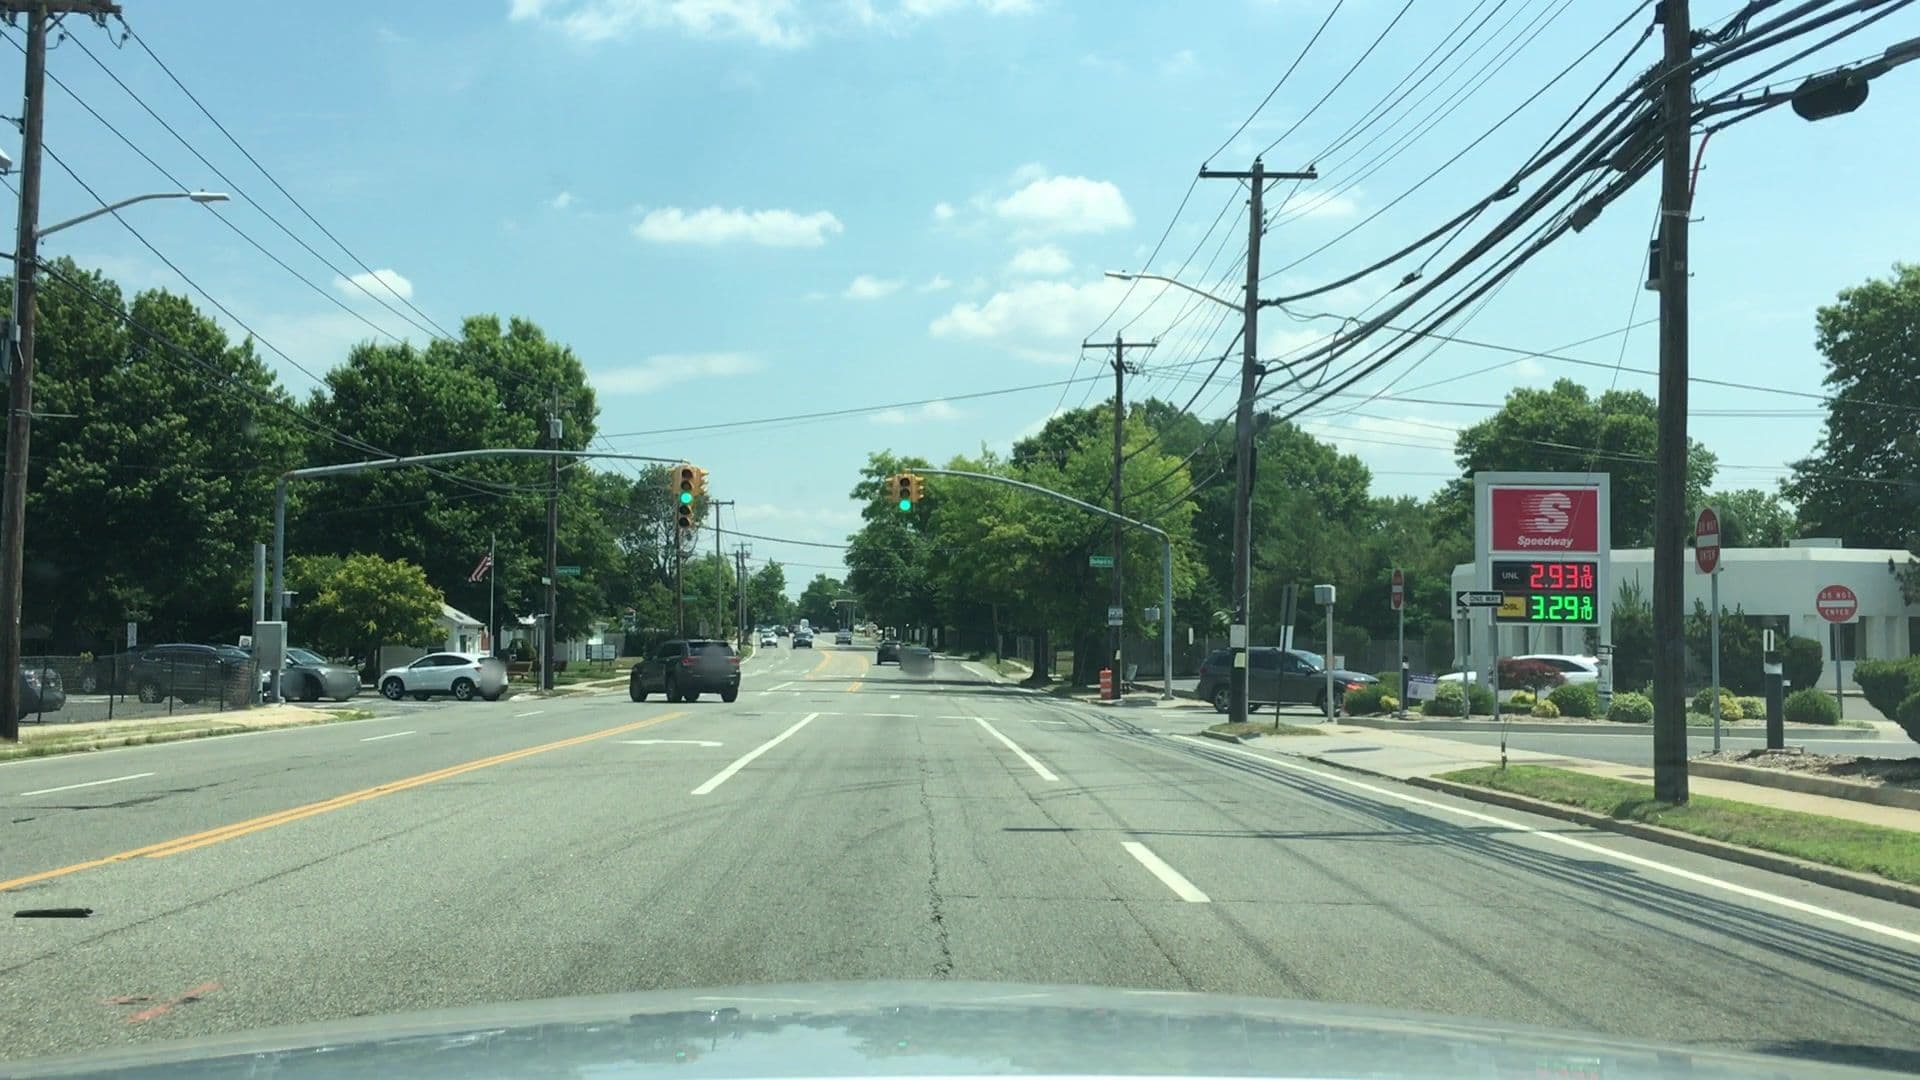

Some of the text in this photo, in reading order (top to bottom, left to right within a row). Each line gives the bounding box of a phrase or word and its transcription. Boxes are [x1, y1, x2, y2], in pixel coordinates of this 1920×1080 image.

[1517, 535, 1574, 548] Speedway
[1502, 571, 1519, 580] UNL
[1530, 564, 1579, 589] 2.93
[1836, 591, 1852, 600] NOT
[1530, 596, 1578, 620] 3.29
[1824, 608, 1849, 616] ENTER
